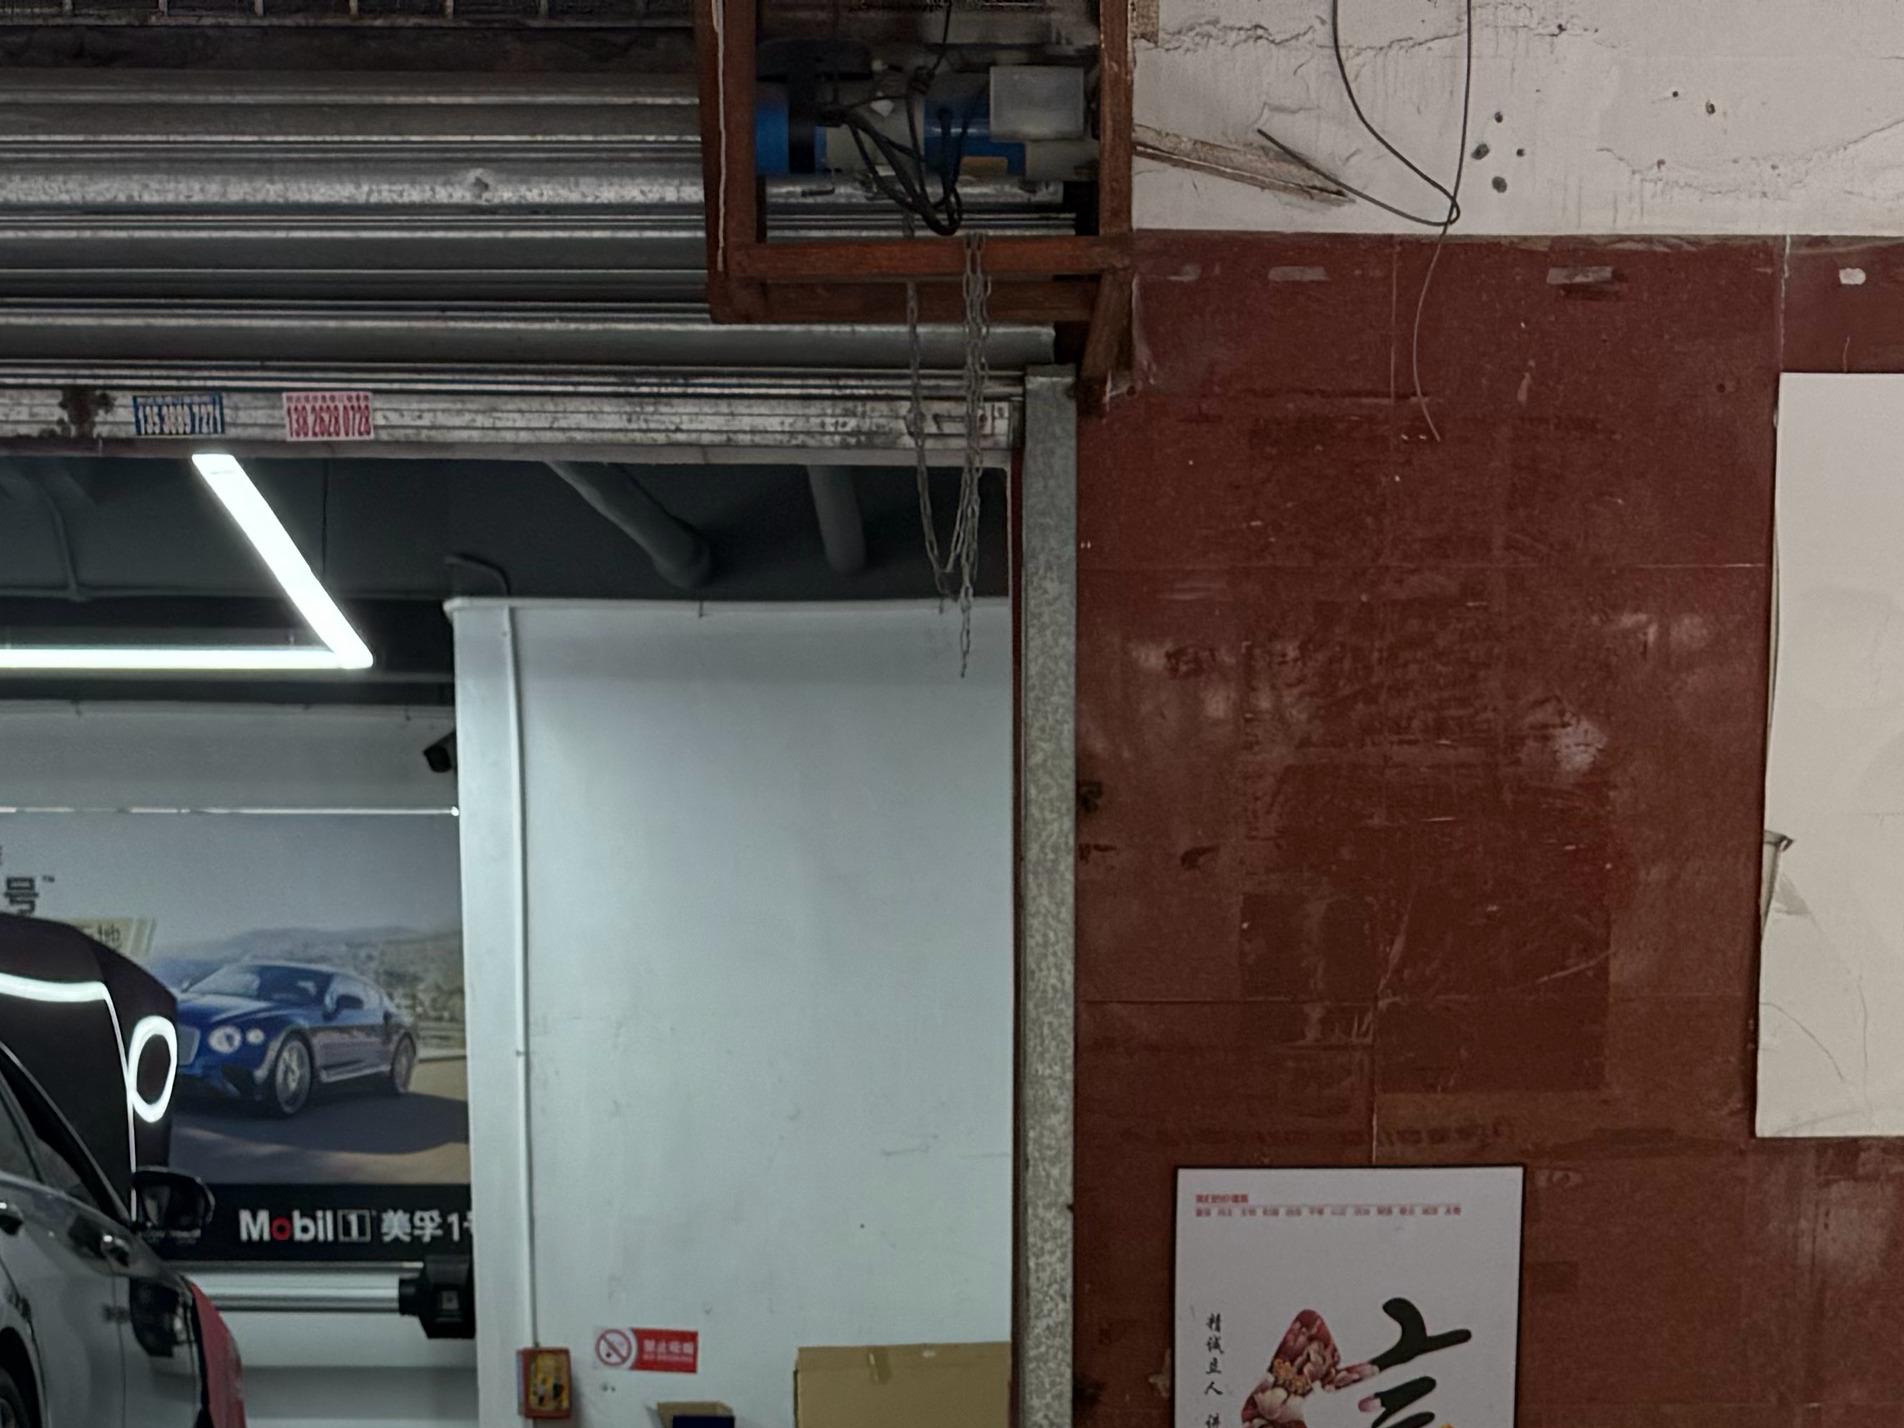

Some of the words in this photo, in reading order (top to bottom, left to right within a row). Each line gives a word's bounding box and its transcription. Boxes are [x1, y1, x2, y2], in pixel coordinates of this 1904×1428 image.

[287, 404, 308, 437] 138
[310, 404, 340, 437] 2628
[343, 403, 372, 436] 0728
[238, 1209, 334, 1242] Mobil
[380, 1209, 473, 1243] 美孚1
